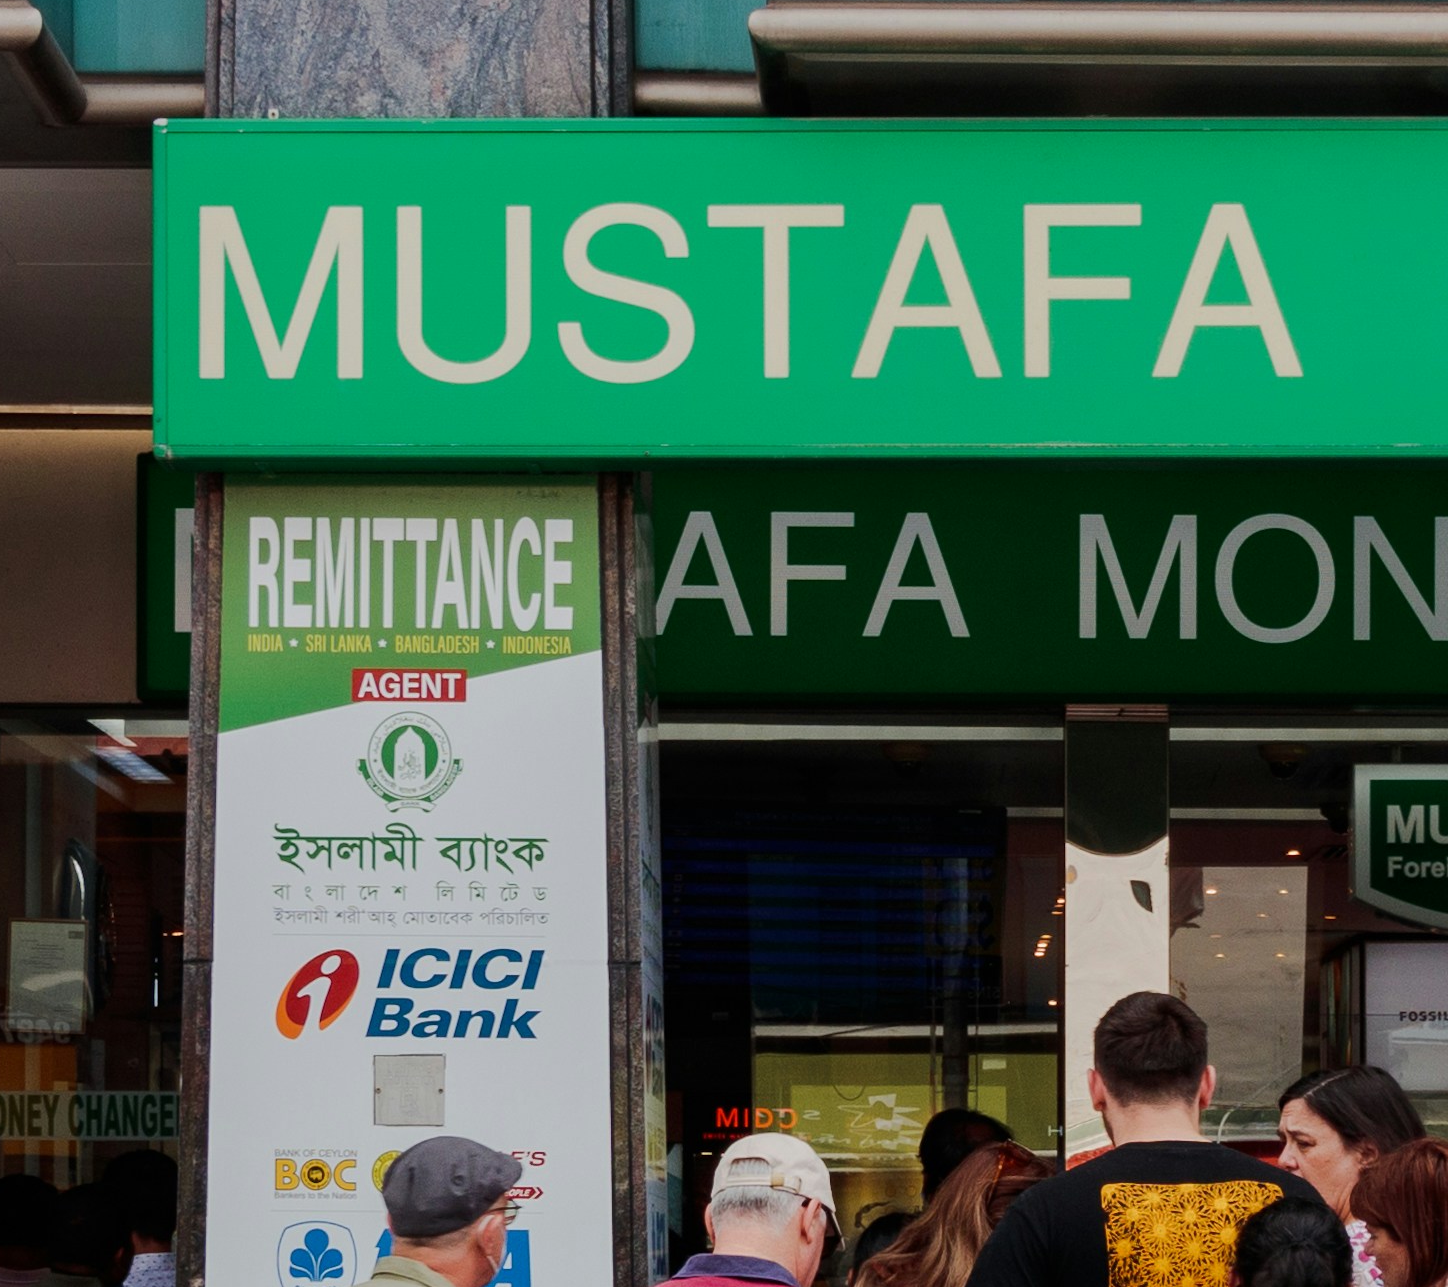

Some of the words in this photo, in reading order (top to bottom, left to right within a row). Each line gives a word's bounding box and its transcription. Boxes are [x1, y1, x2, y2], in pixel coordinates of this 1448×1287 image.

[198, 201, 1303, 384] MUSTAFA
[248, 516, 573, 632] REMITTANCE
[248, 634, 283, 653] INDIA
[306, 634, 330, 653] SRI
[333, 634, 373, 654] LANKA
[395, 635, 480, 654] BANGLADESH
[502, 636, 572, 655] INDONESIA
[357, 672, 462, 700] AGENT
[273, 822, 424, 873] ইসলামী
[436, 832, 549, 874] ব্যাংক
[273, 905, 328, 925] ইসলামী
[377, 948, 546, 990] ICICI
[366, 997, 538, 1039] Bank
[274, 1149, 299, 1157] BANK
[301, 1149, 315, 1157] OF
[317, 1149, 358, 1158] CEYLON
[331, 1192, 358, 1200] Nation
